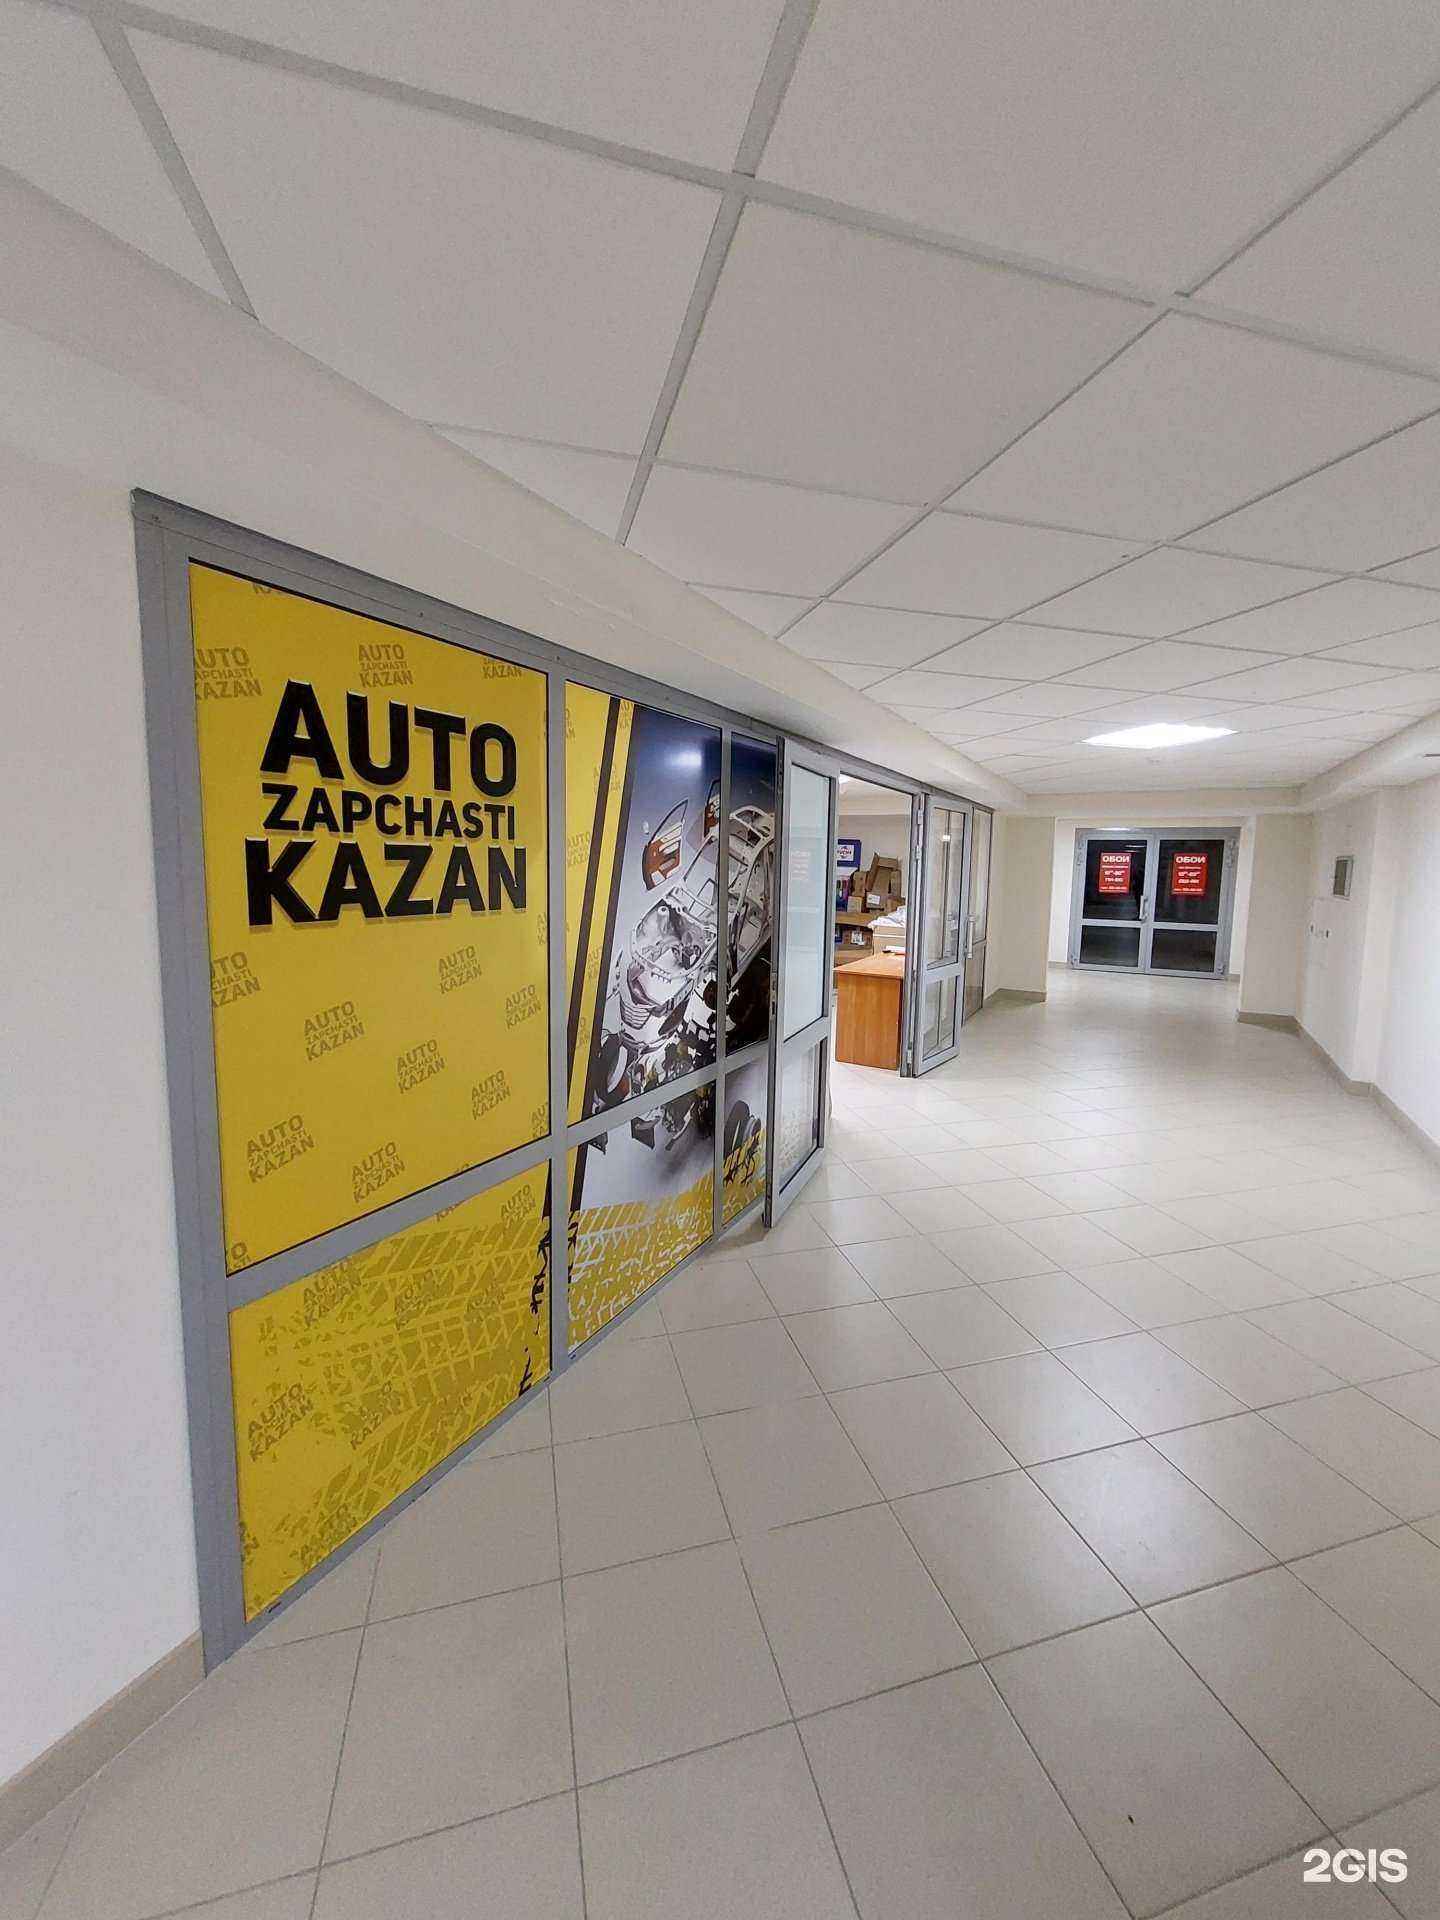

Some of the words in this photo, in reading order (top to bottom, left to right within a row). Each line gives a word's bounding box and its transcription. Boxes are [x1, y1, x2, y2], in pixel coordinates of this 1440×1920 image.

[358, 643, 405, 662] AUTO
[360, 670, 414, 688] KAZAN
[260, 679, 517, 797] AUTO
[261, 783, 515, 840] ZAPCHASTI
[1102, 855, 1130, 863] ОБОИ
[1175, 856, 1206, 864] ОБОИ
[245, 837, 527, 926] KAZAN
[439, 945, 476, 974] AUTO
[440, 964, 483, 994] KAZAN
[505, 984, 536, 1010] AUTO
[304, 1000, 355, 1034] AUTO
[505, 1000, 543, 1030] KAZAN
[306, 1021, 366, 1061] KAZAN
[398, 1039, 437, 1074] AUTO
[398, 1057, 445, 1094] KAZAN
[472, 1070, 505, 1101] AUTO
[472, 1086, 512, 1120] KAZAN
[247, 1114, 303, 1158] AUTO
[248, 1134, 315, 1184] KAZAN
[352, 1141, 396, 1182] AUTO
[353, 1159, 405, 1203] KAZAN
[501, 1184, 530, 1217] AUTO
[248, 1382, 304, 1440] AUTO
[249, 1398, 314, 1462] KAZAN
